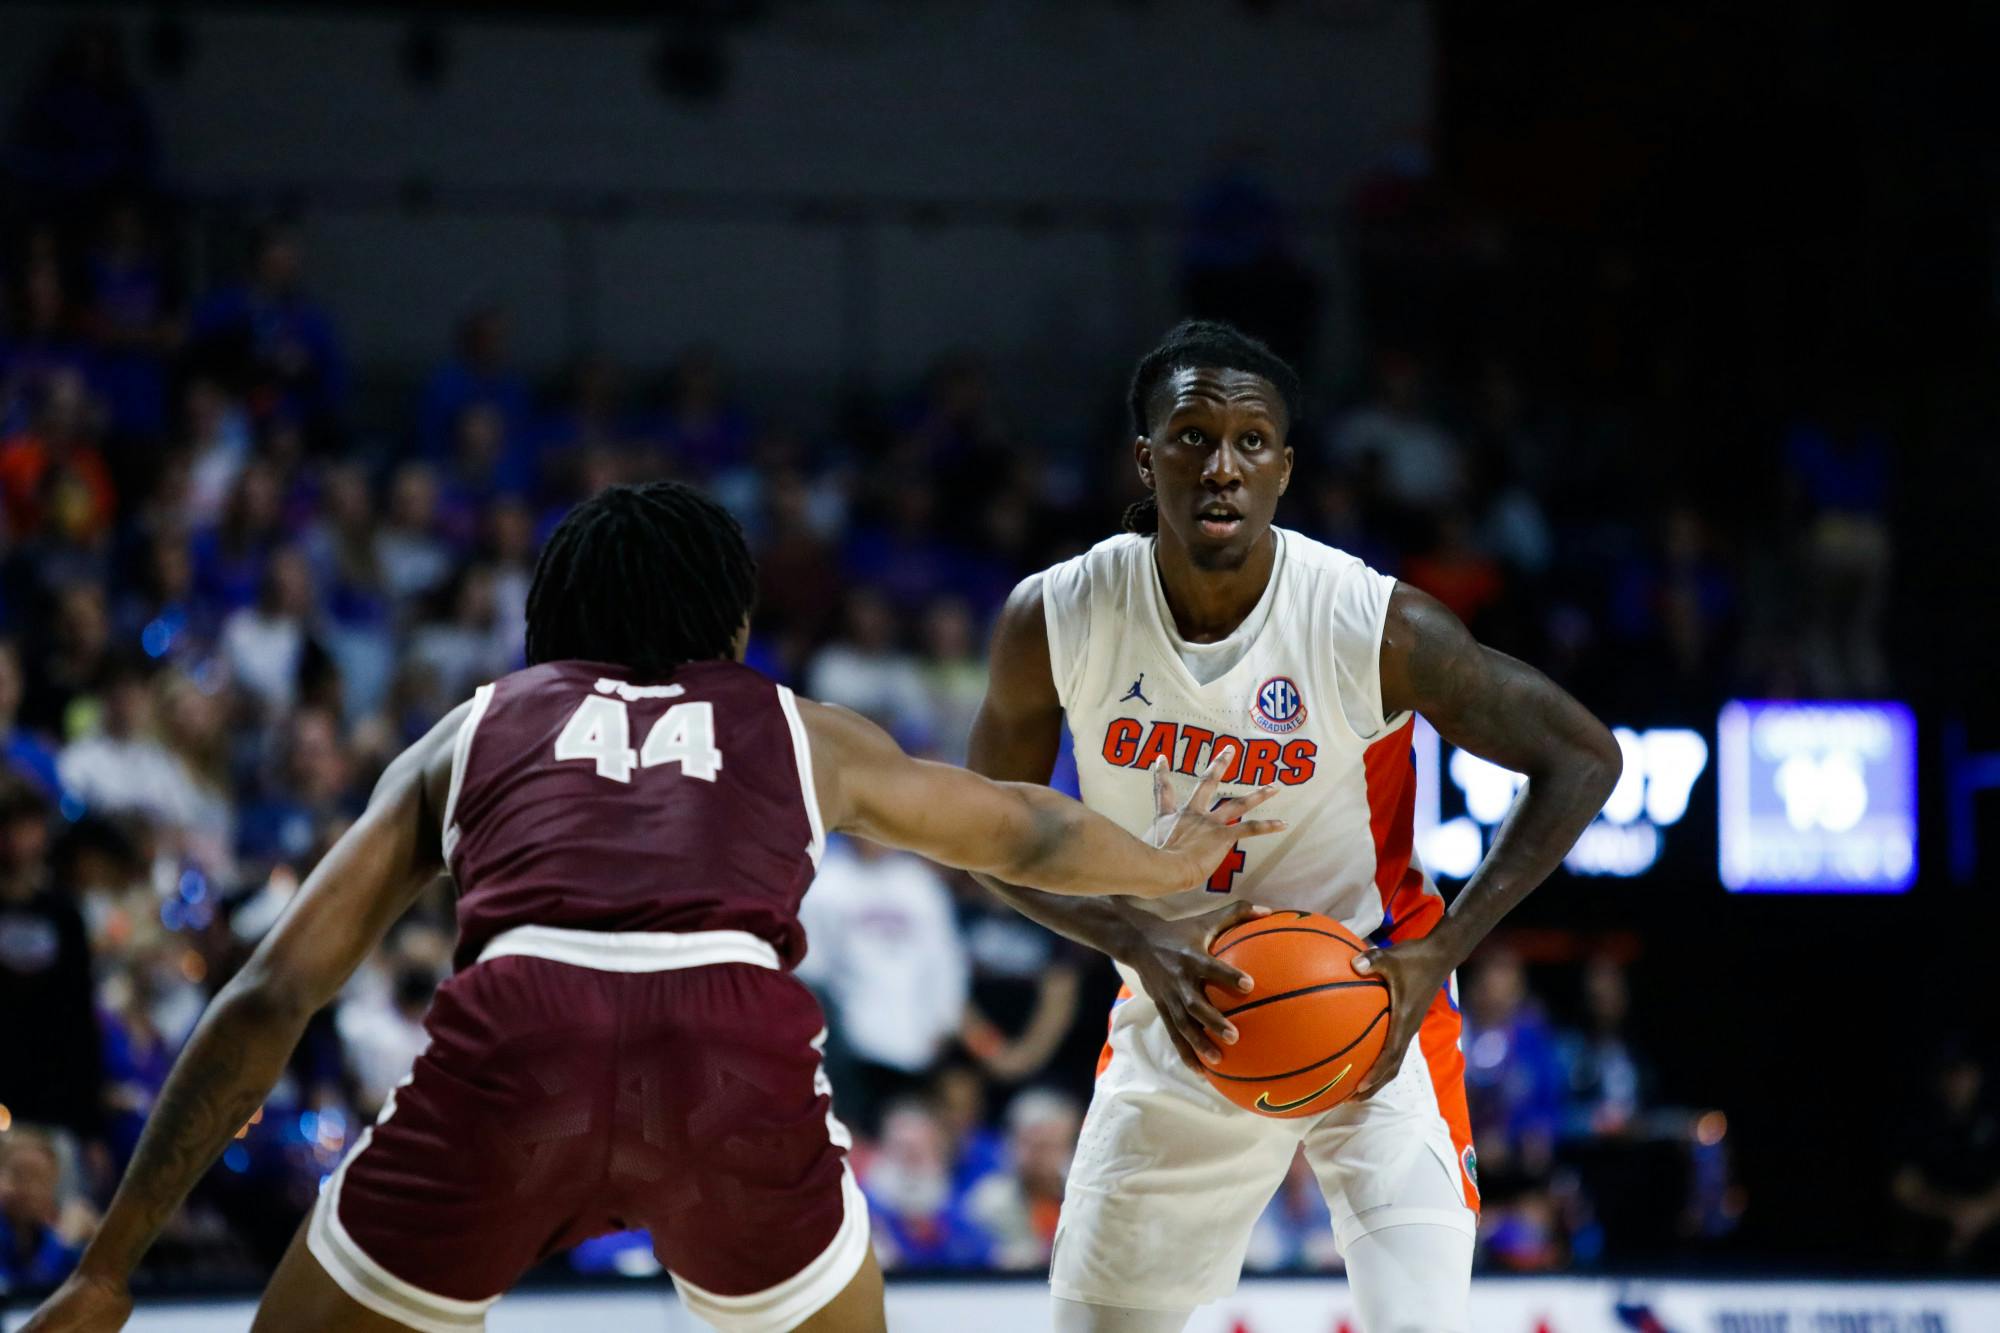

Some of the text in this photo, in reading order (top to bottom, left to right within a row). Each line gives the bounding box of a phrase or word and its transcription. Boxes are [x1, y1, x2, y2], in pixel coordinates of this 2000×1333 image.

[1256, 716, 1303, 732] GRADUATE
[1260, 680, 1297, 719] SEC
[555, 694, 722, 783] 44
[1102, 717, 1318, 786] GATORS
